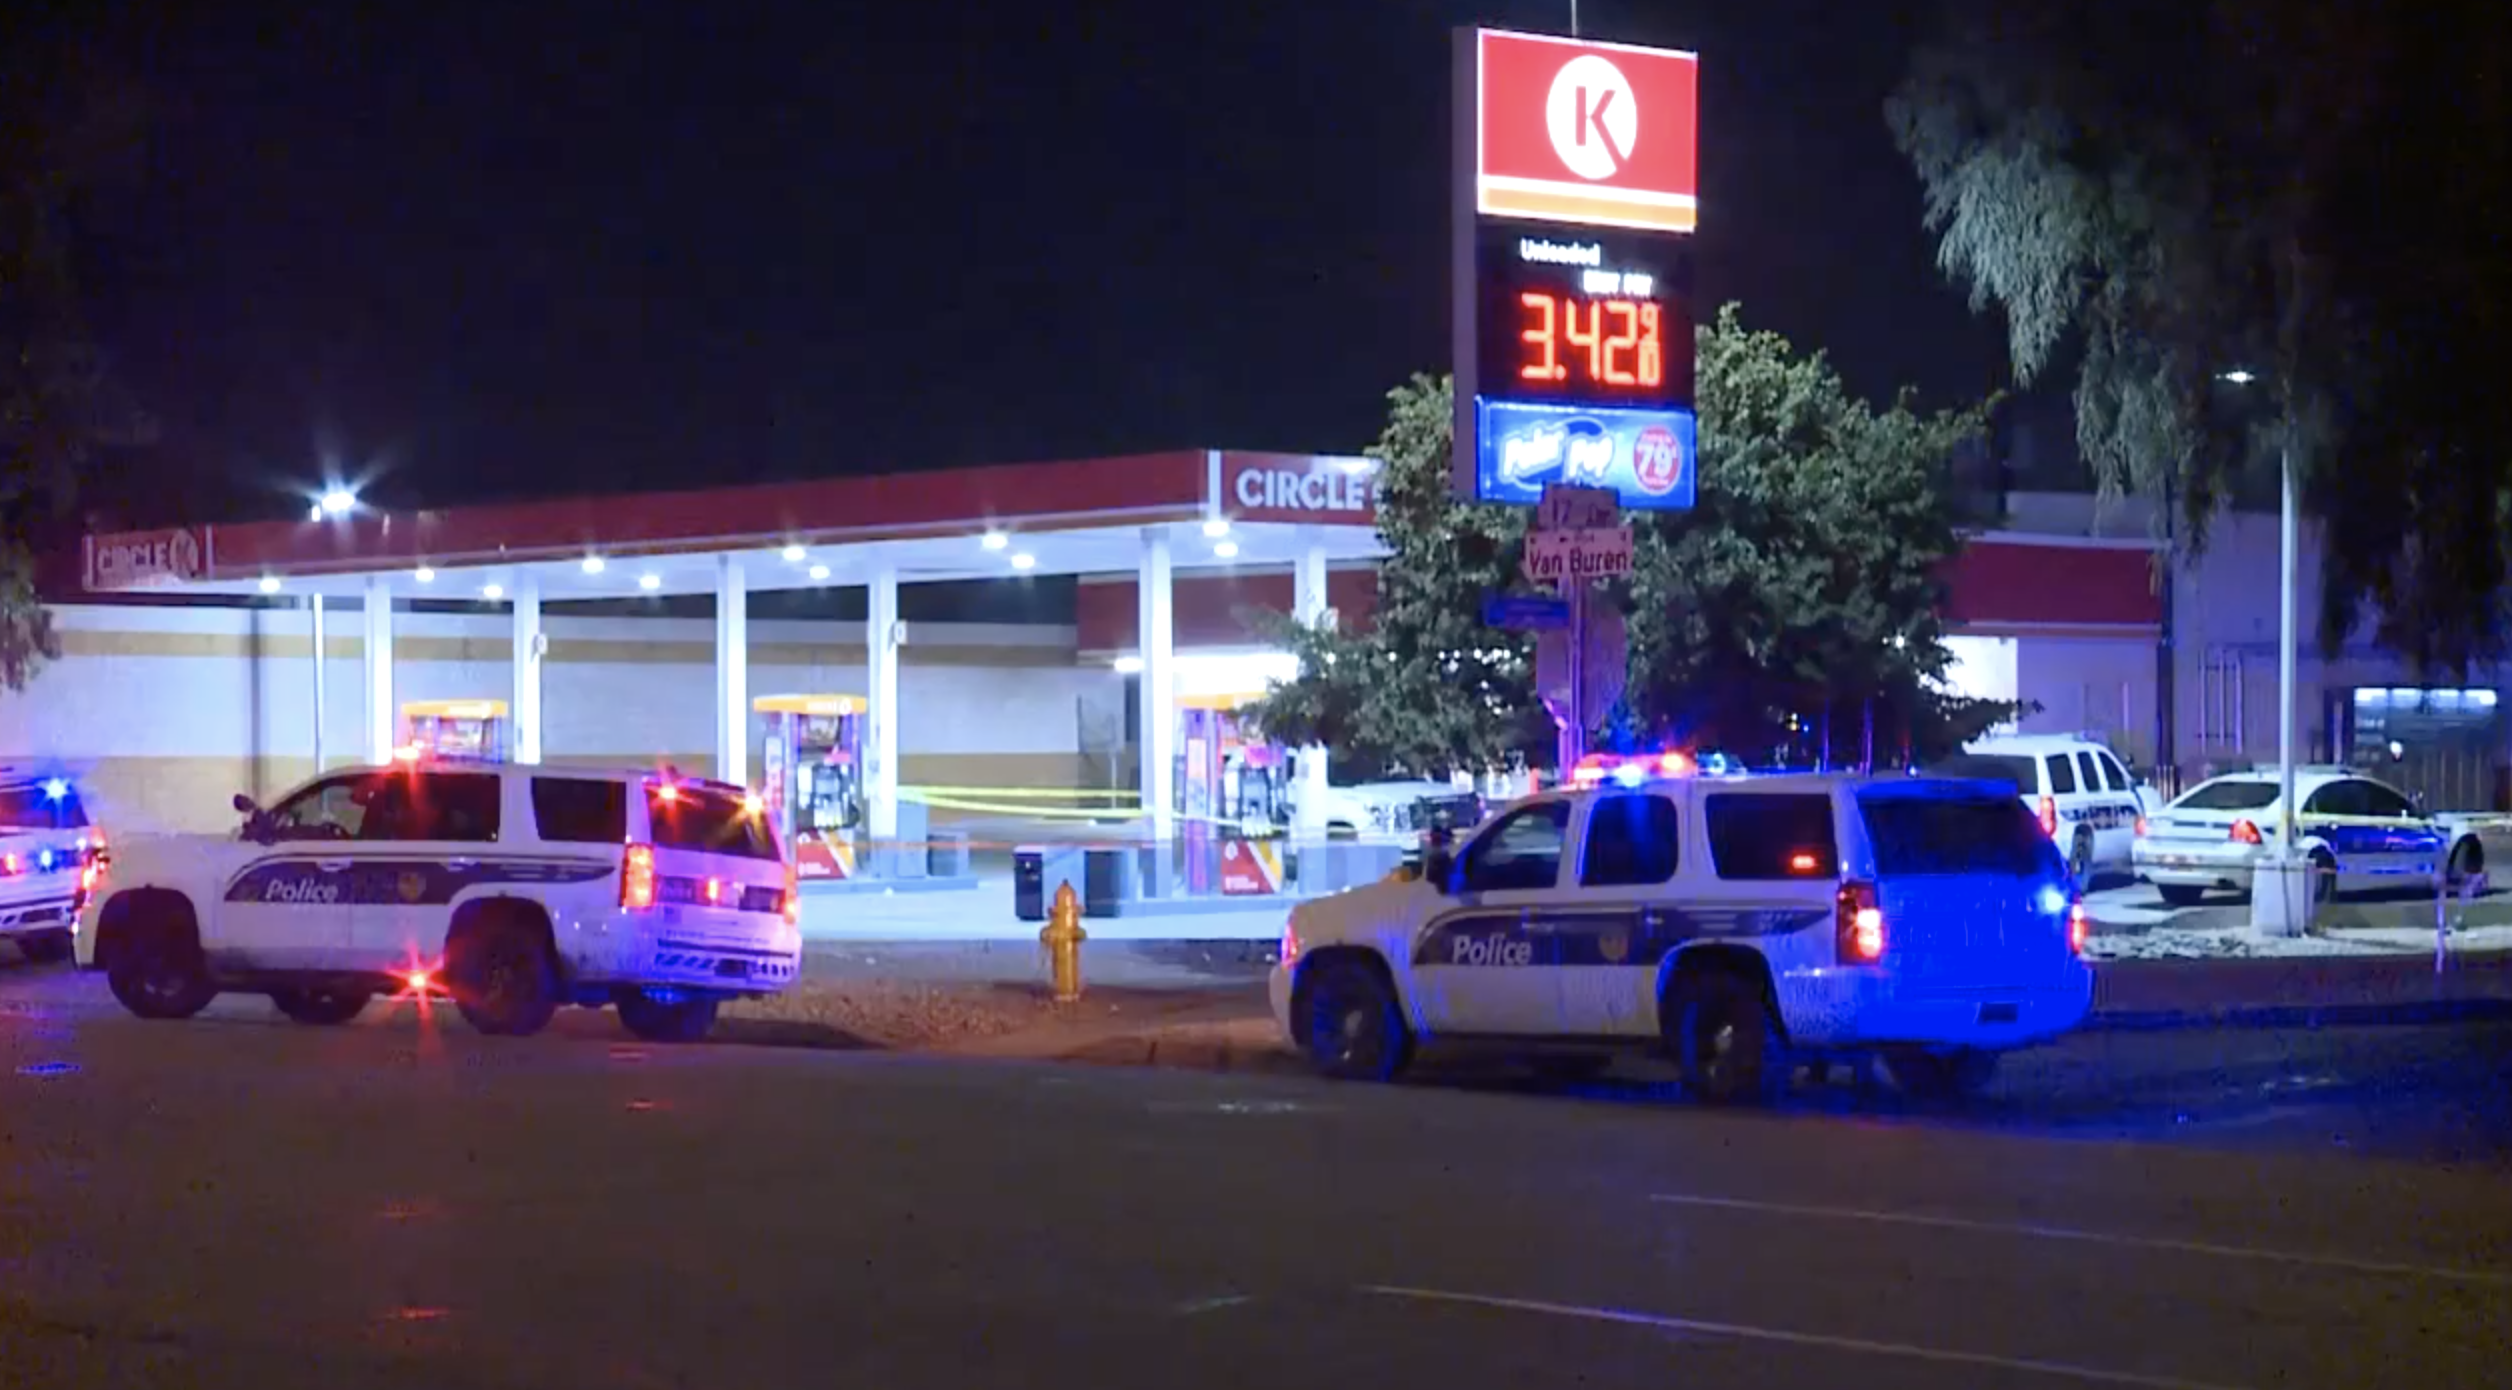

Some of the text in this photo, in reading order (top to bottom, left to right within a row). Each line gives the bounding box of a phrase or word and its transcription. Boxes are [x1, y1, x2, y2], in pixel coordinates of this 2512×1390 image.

[1236, 468, 1365, 511] CIRCLE
[97, 542, 168, 573] CIRCLE
[1529, 547, 1627, 575] Van Buren
[265, 878, 339, 903] Police
[1452, 934, 1532, 965] Police
